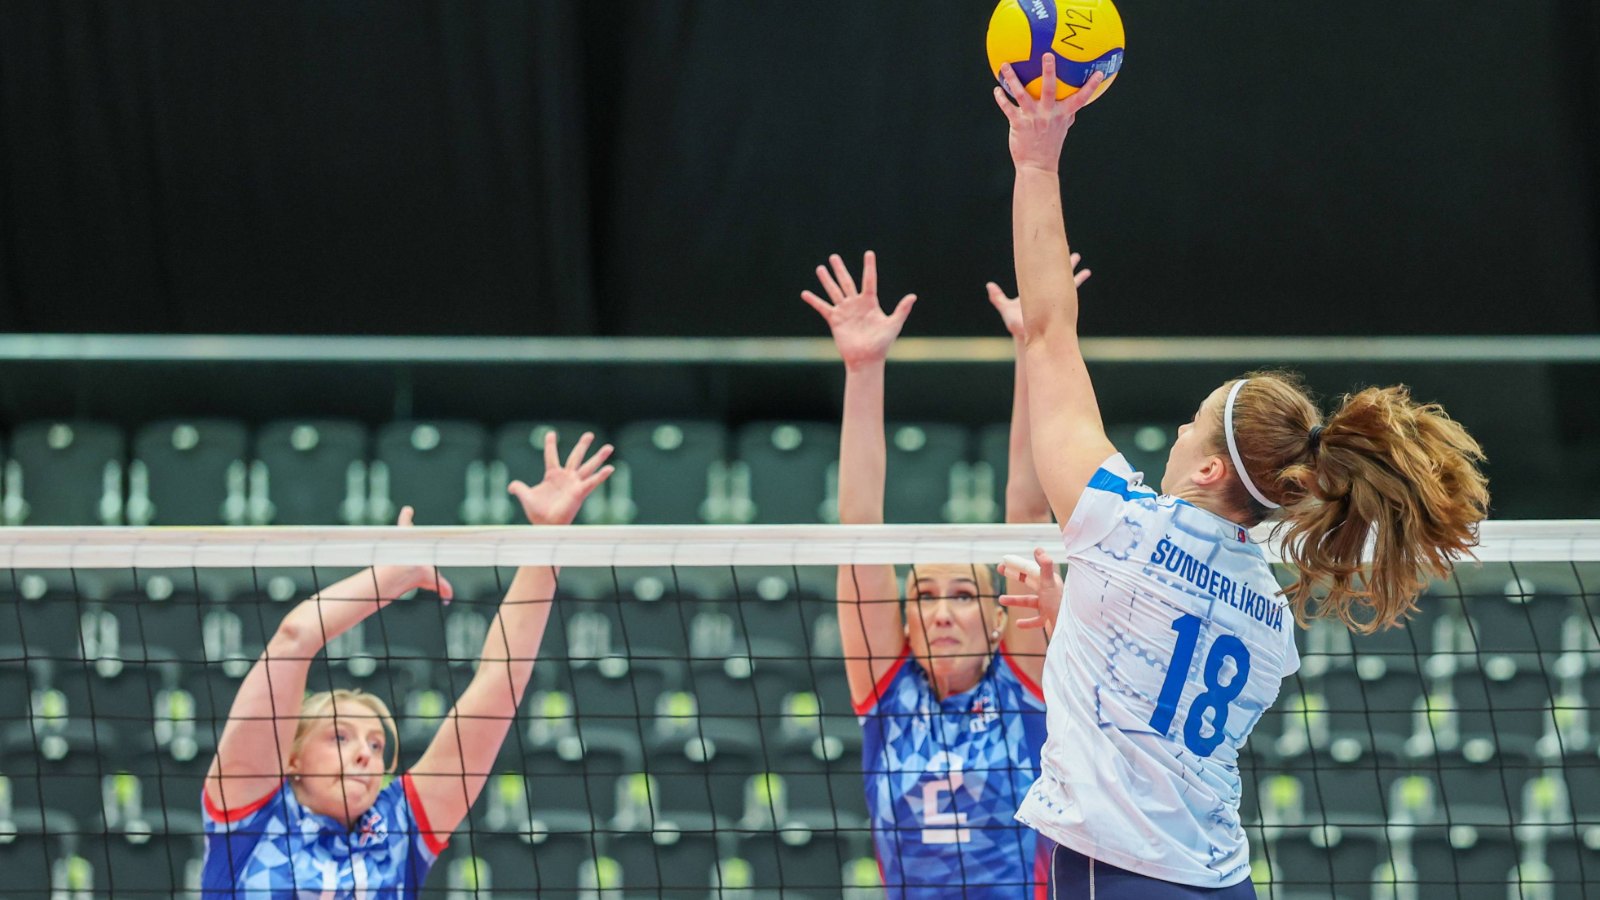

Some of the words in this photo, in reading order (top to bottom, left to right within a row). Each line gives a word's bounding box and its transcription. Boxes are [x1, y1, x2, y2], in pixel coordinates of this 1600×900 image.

[1060, 8, 1093, 51] M2
[1150, 534, 1284, 633] ŠUNDERLÍKOVÁ
[1149, 612, 1251, 758] 18
[922, 750, 968, 826] 2
